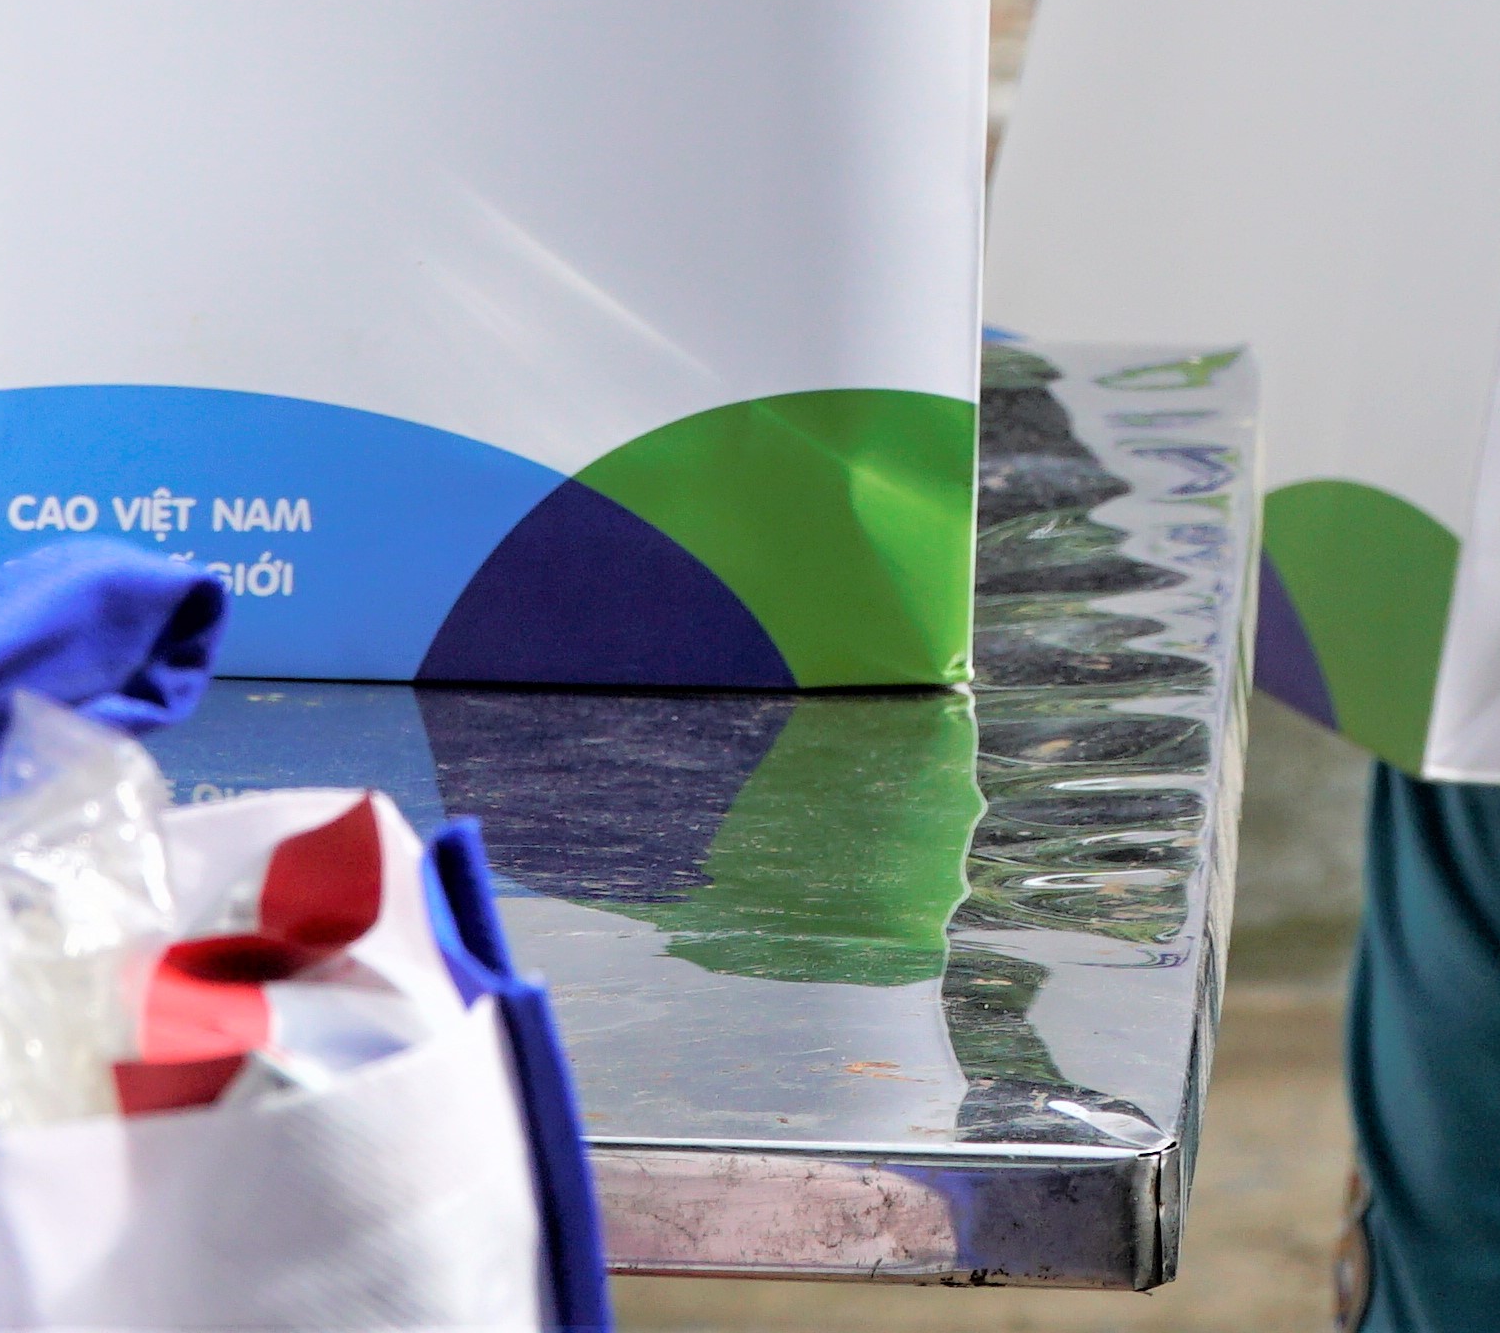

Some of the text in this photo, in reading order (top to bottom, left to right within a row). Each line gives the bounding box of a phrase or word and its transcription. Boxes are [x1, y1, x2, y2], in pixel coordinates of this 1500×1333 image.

[7, 494, 99, 532] CAO
[111, 486, 197, 542] VIỆT
[212, 496, 312, 533] NAM
